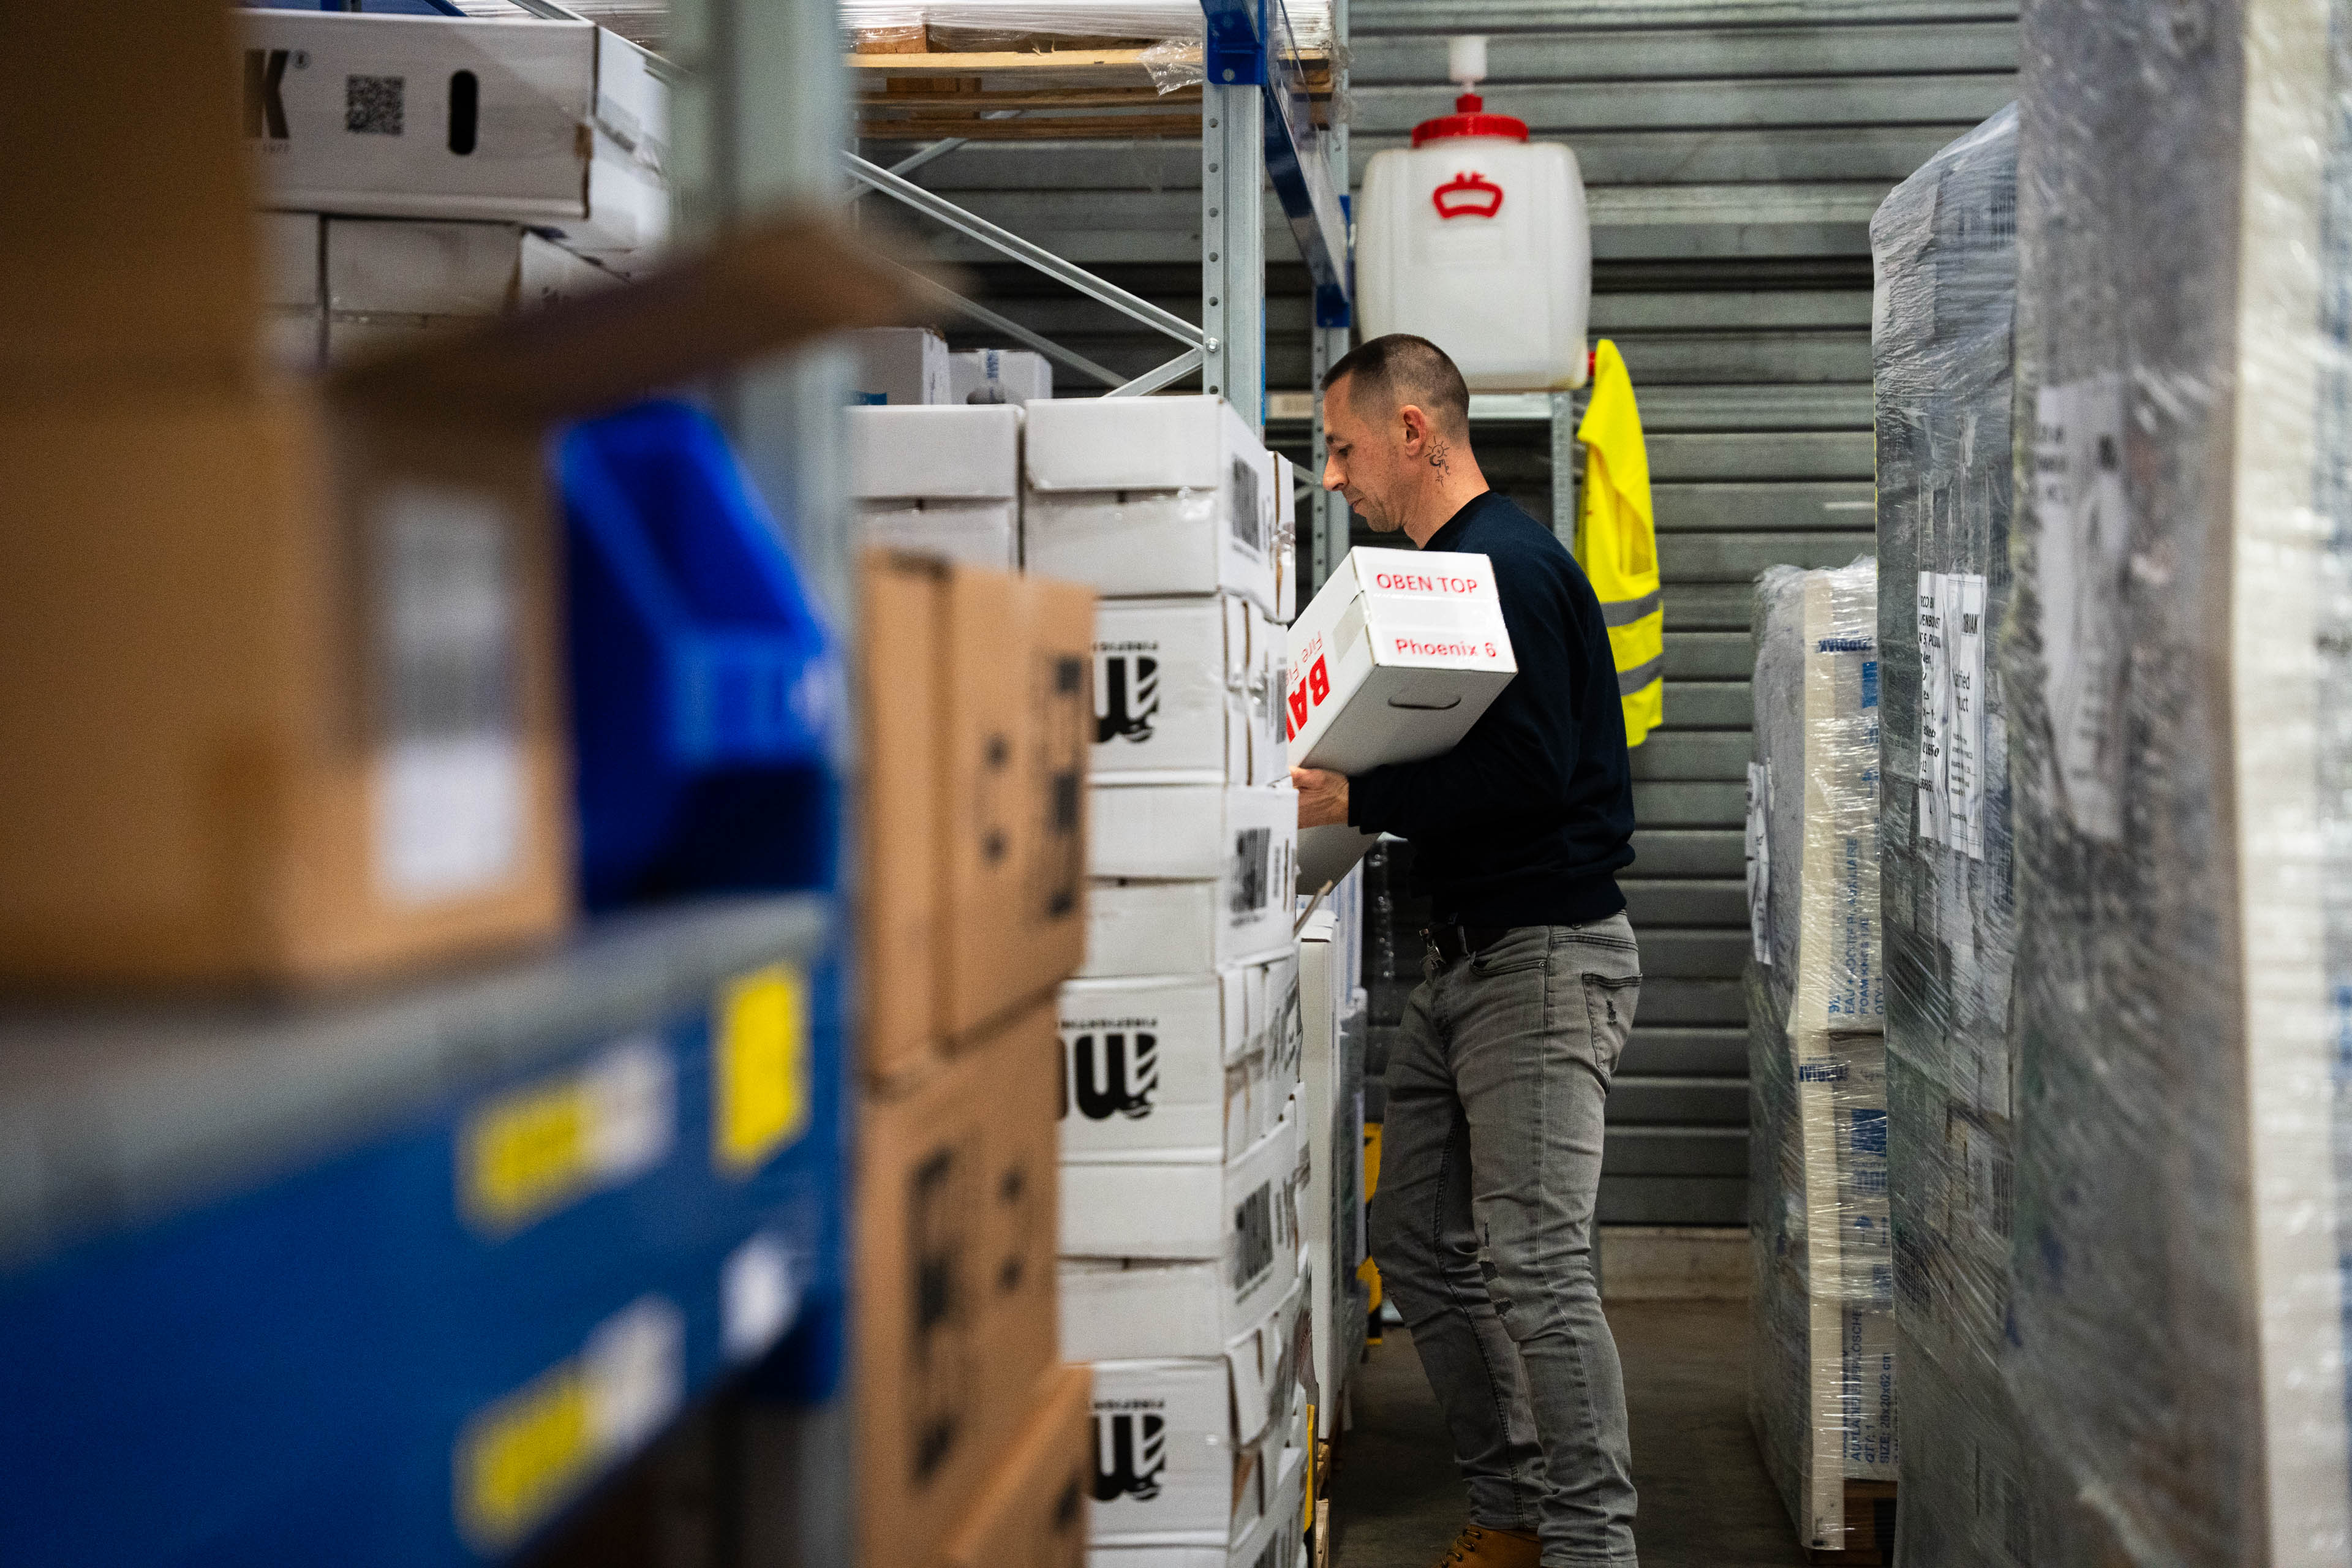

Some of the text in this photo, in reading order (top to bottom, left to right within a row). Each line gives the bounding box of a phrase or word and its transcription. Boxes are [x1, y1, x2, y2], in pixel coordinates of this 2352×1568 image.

[1376, 573, 1478, 594] OBEN TOP
[1301, 630, 1323, 663] Fire
[1395, 638, 1496, 657] Phoenix 6
